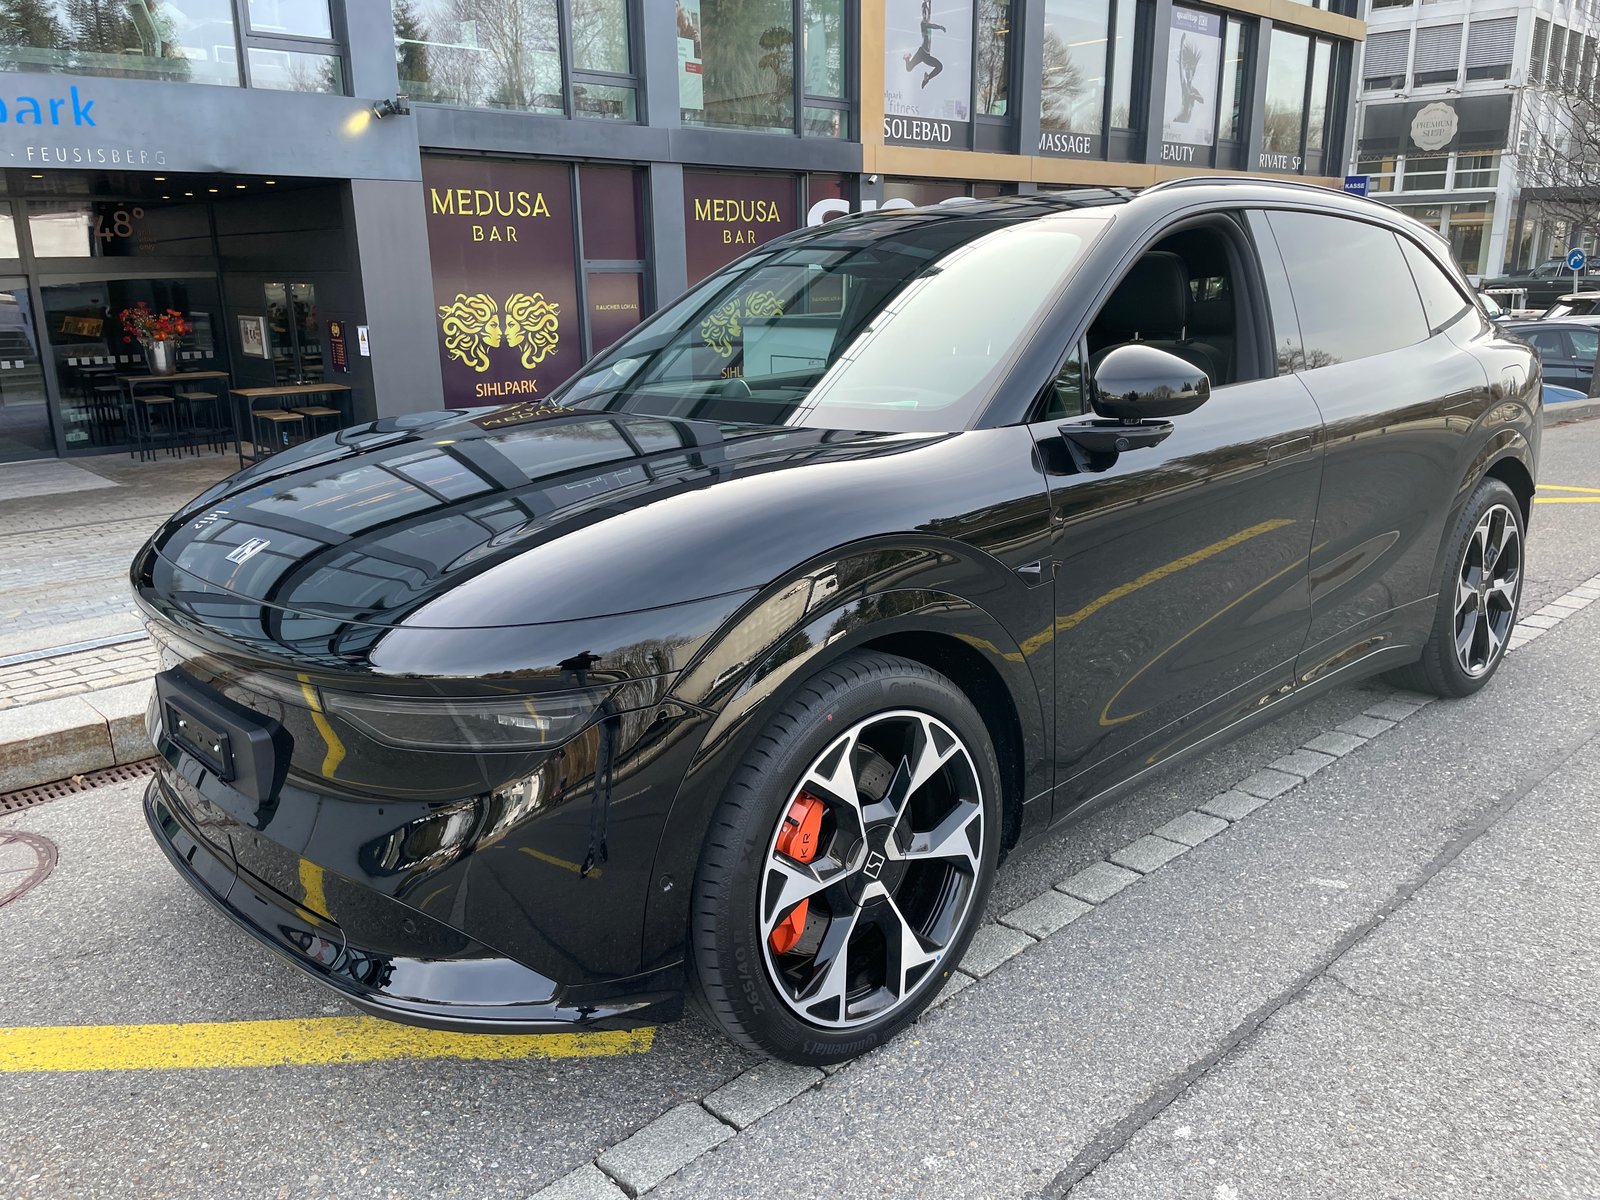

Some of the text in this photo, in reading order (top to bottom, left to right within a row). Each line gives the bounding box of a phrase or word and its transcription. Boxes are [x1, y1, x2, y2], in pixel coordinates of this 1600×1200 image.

[889, 101, 920, 116] fitness
[884, 117, 952, 143] SOLEBAD
[26, 146, 167, 166] FEUSISBERG
[1291, 156, 1307, 170] SP
[1345, 182, 1366, 190] KASSE
[430, 188, 551, 218] MEDUSA
[694, 198, 781, 223] MEDUSA
[472, 225, 518, 243] BAR
[723, 229, 757, 245] BAR
[475, 379, 539, 398] SIHLPARK
